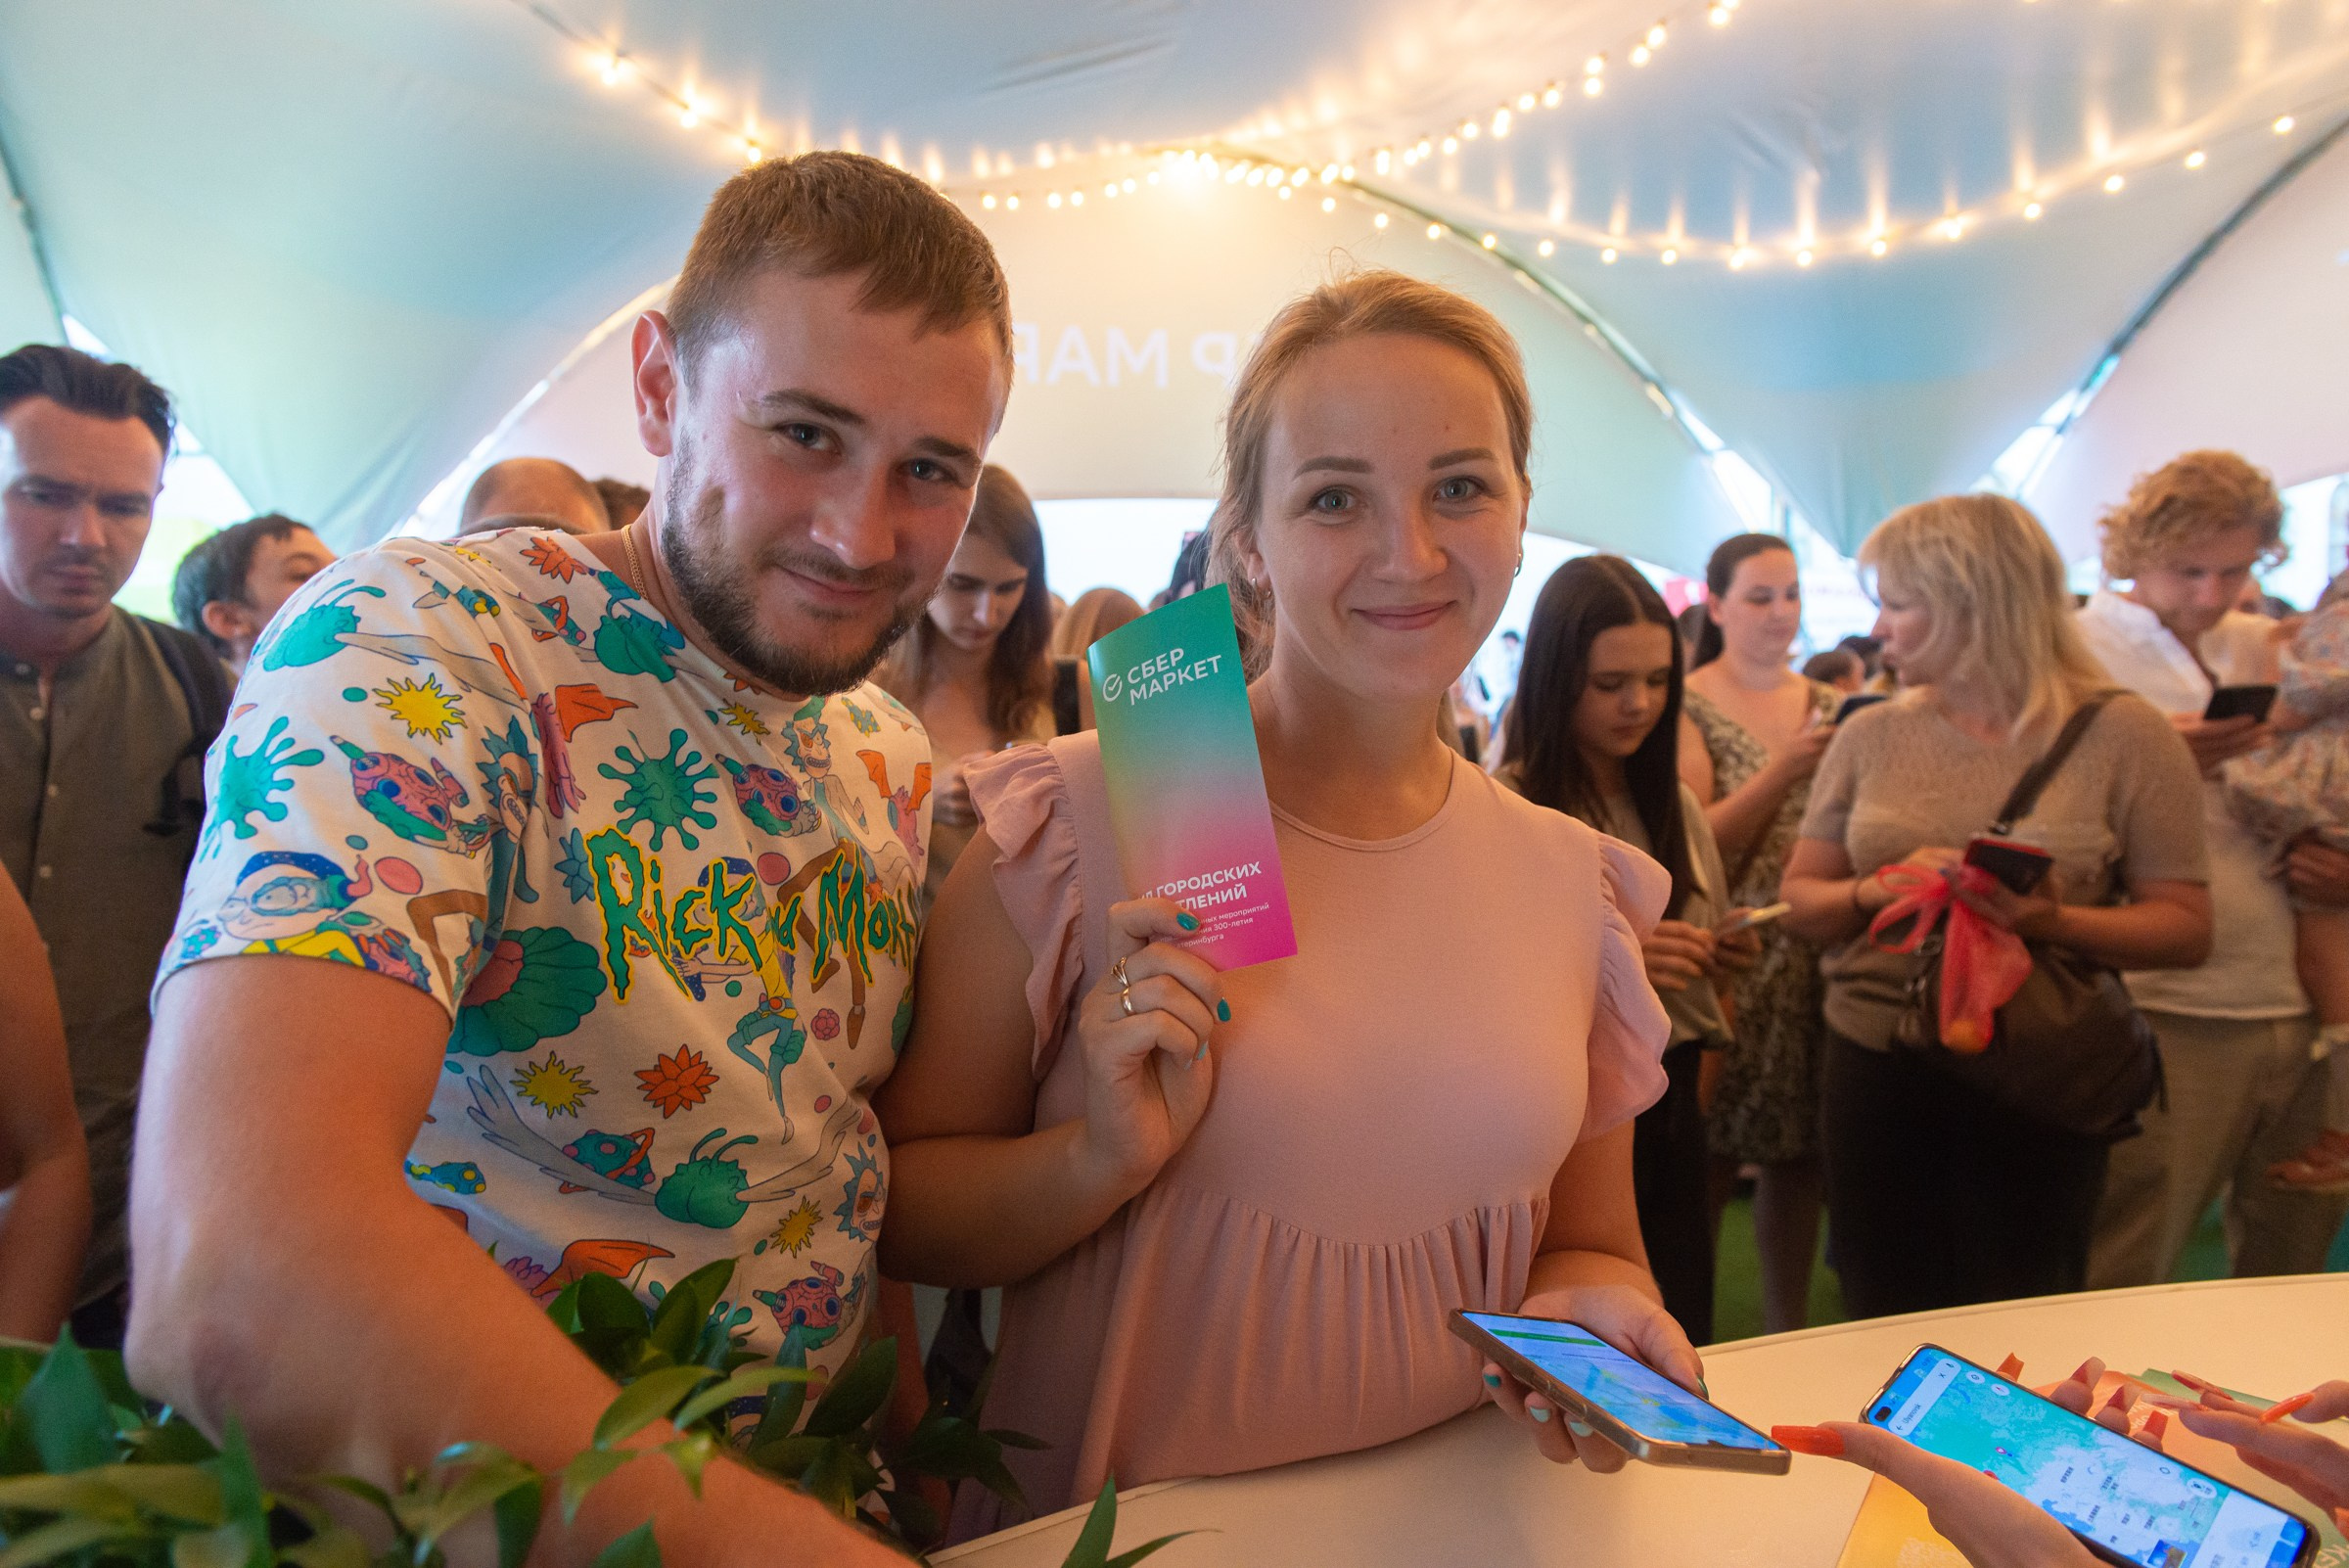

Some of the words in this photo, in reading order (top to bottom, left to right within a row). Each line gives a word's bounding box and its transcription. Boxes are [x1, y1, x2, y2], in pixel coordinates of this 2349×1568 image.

[1127, 647, 1184, 684] СБЕР
[1129, 655, 1221, 706] МАРКЕТ
[1156, 861, 1262, 898] ГОРОДСКИХ
[1175, 883, 1248, 910] ТЛЕНИЙ
[1214, 917, 1254, 931] 300-летия
[1219, 902, 1269, 921] мероприятий
[1176, 934, 1224, 948] теринбурга
